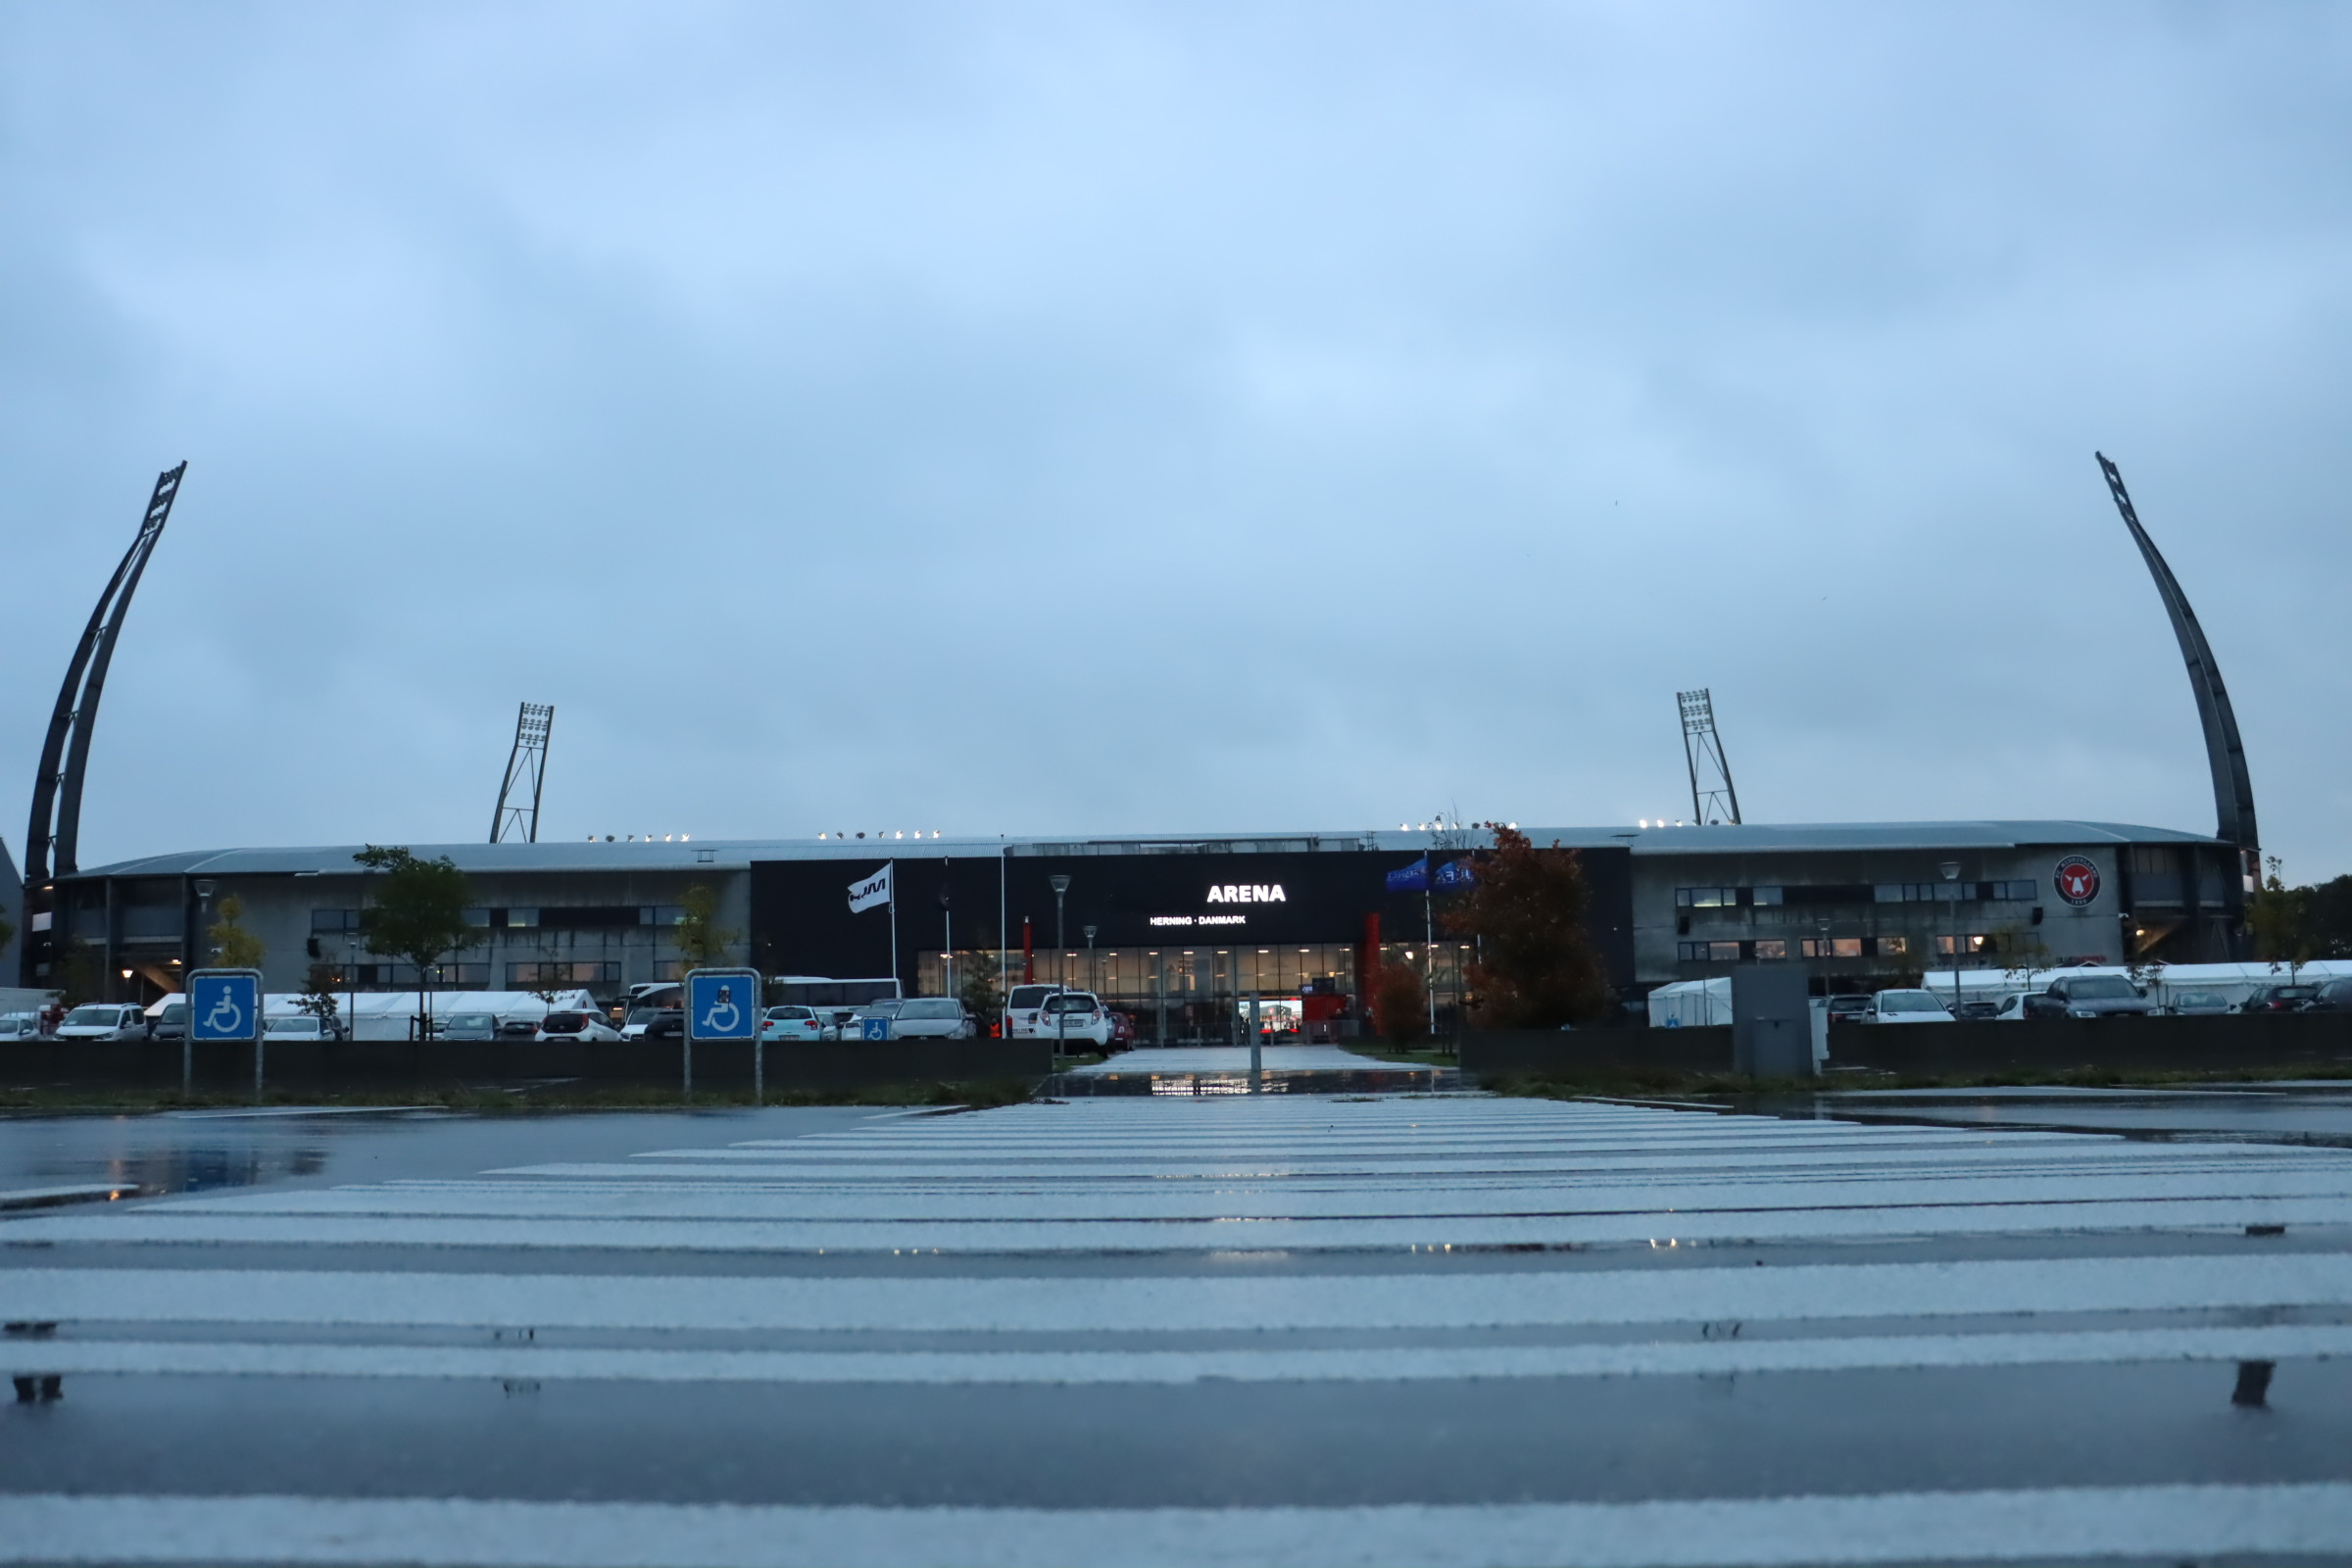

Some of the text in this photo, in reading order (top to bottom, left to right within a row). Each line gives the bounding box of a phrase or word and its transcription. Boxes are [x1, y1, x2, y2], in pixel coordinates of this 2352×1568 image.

[1206, 885, 1286, 903] ARENA
[1150, 915, 1246, 925] HERNING DANMARK
